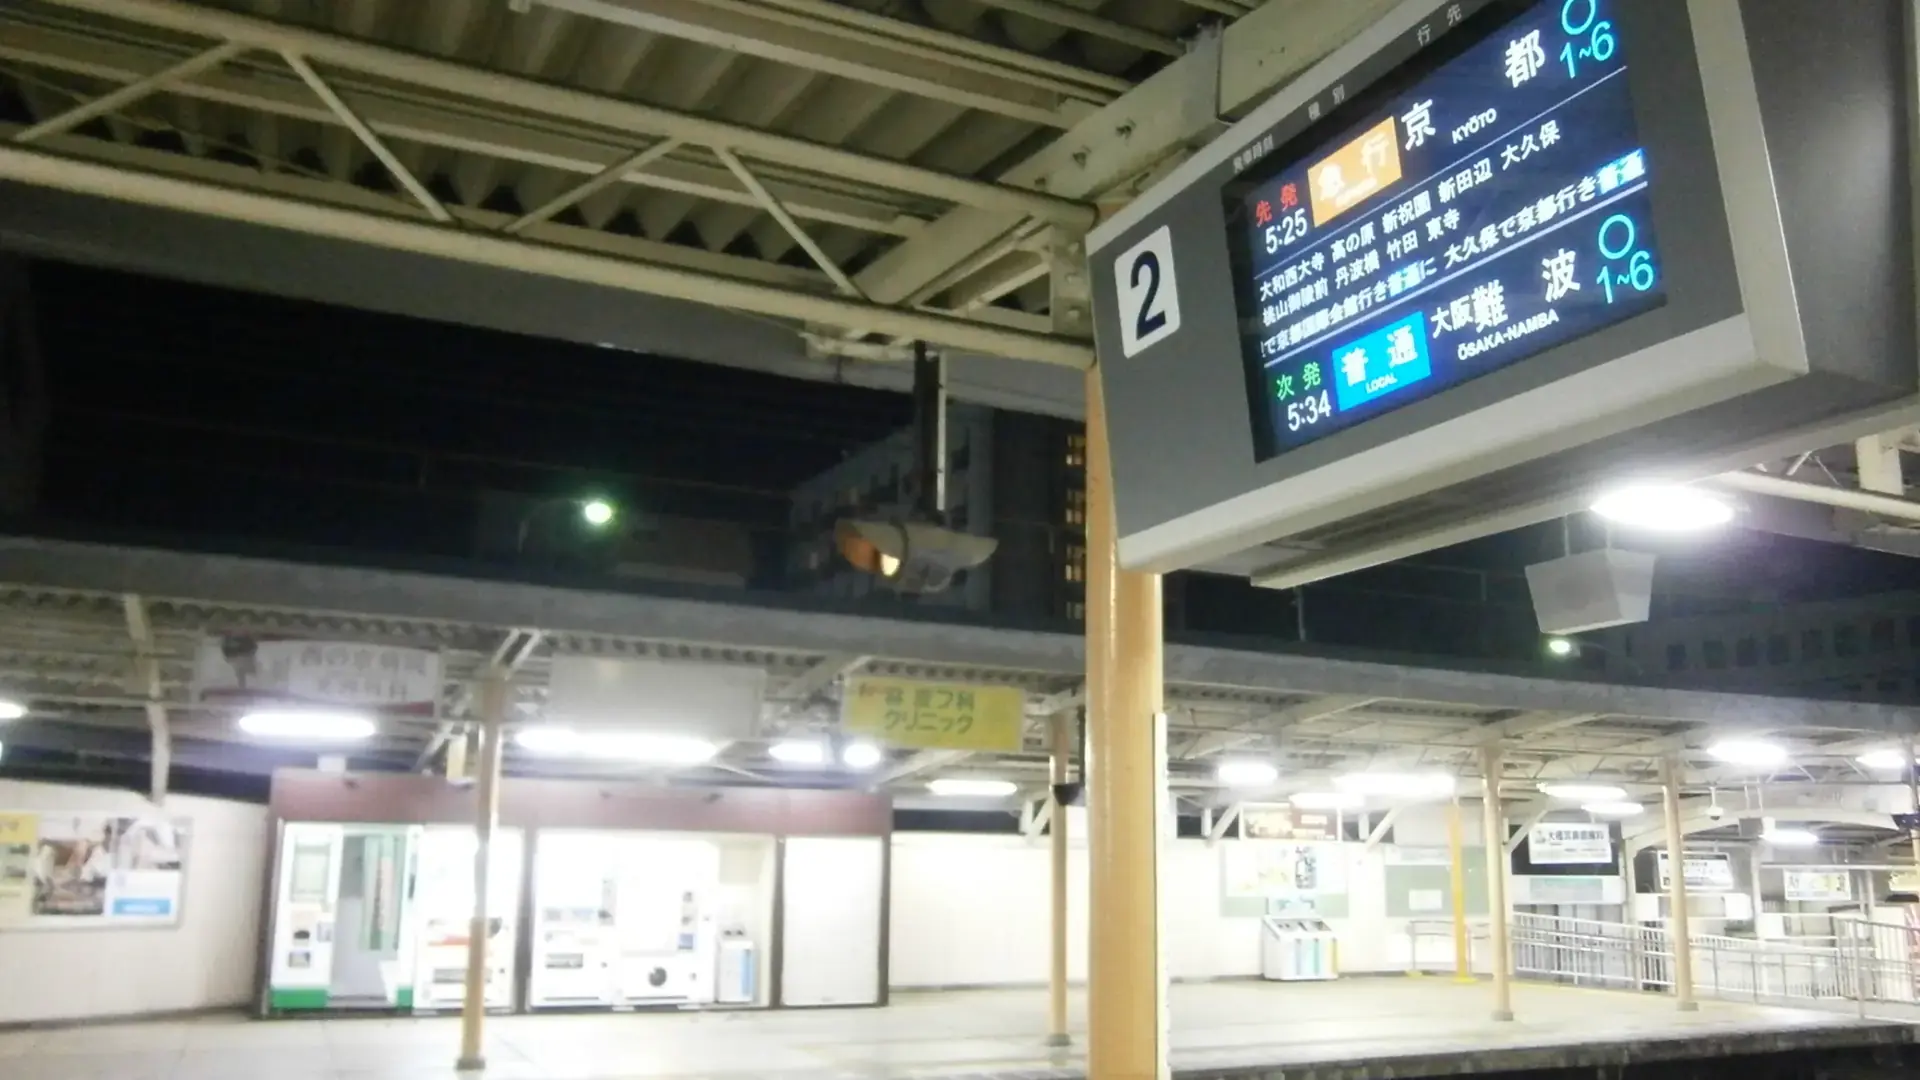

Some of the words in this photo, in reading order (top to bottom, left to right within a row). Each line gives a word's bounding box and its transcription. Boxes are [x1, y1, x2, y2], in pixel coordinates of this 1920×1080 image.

[1417, 4, 1462, 47] 行先
[1255, 183, 1298, 226] 先発
[1260, 252, 1325, 301] 大和西大寺
[1382, 190, 1431, 234] 新祝園
[1438, 157, 1492, 203] 新田辺
[1501, 122, 1561, 170] 大久保
[1265, 209, 1307, 253] 5:25
[1335, 248, 1380, 290] 丹波橋
[1386, 234, 1418, 262] 竹田
[1426, 208, 1460, 241] 東寺
[1130, 250, 1167, 341] 2
[1341, 324, 1419, 386] 普通
[1276, 362, 1321, 400] 次発
[1365, 374, 1397, 394] LOCAL
[1287, 389, 1331, 431] 5:34
[884, 708, 974, 734] クリニック
